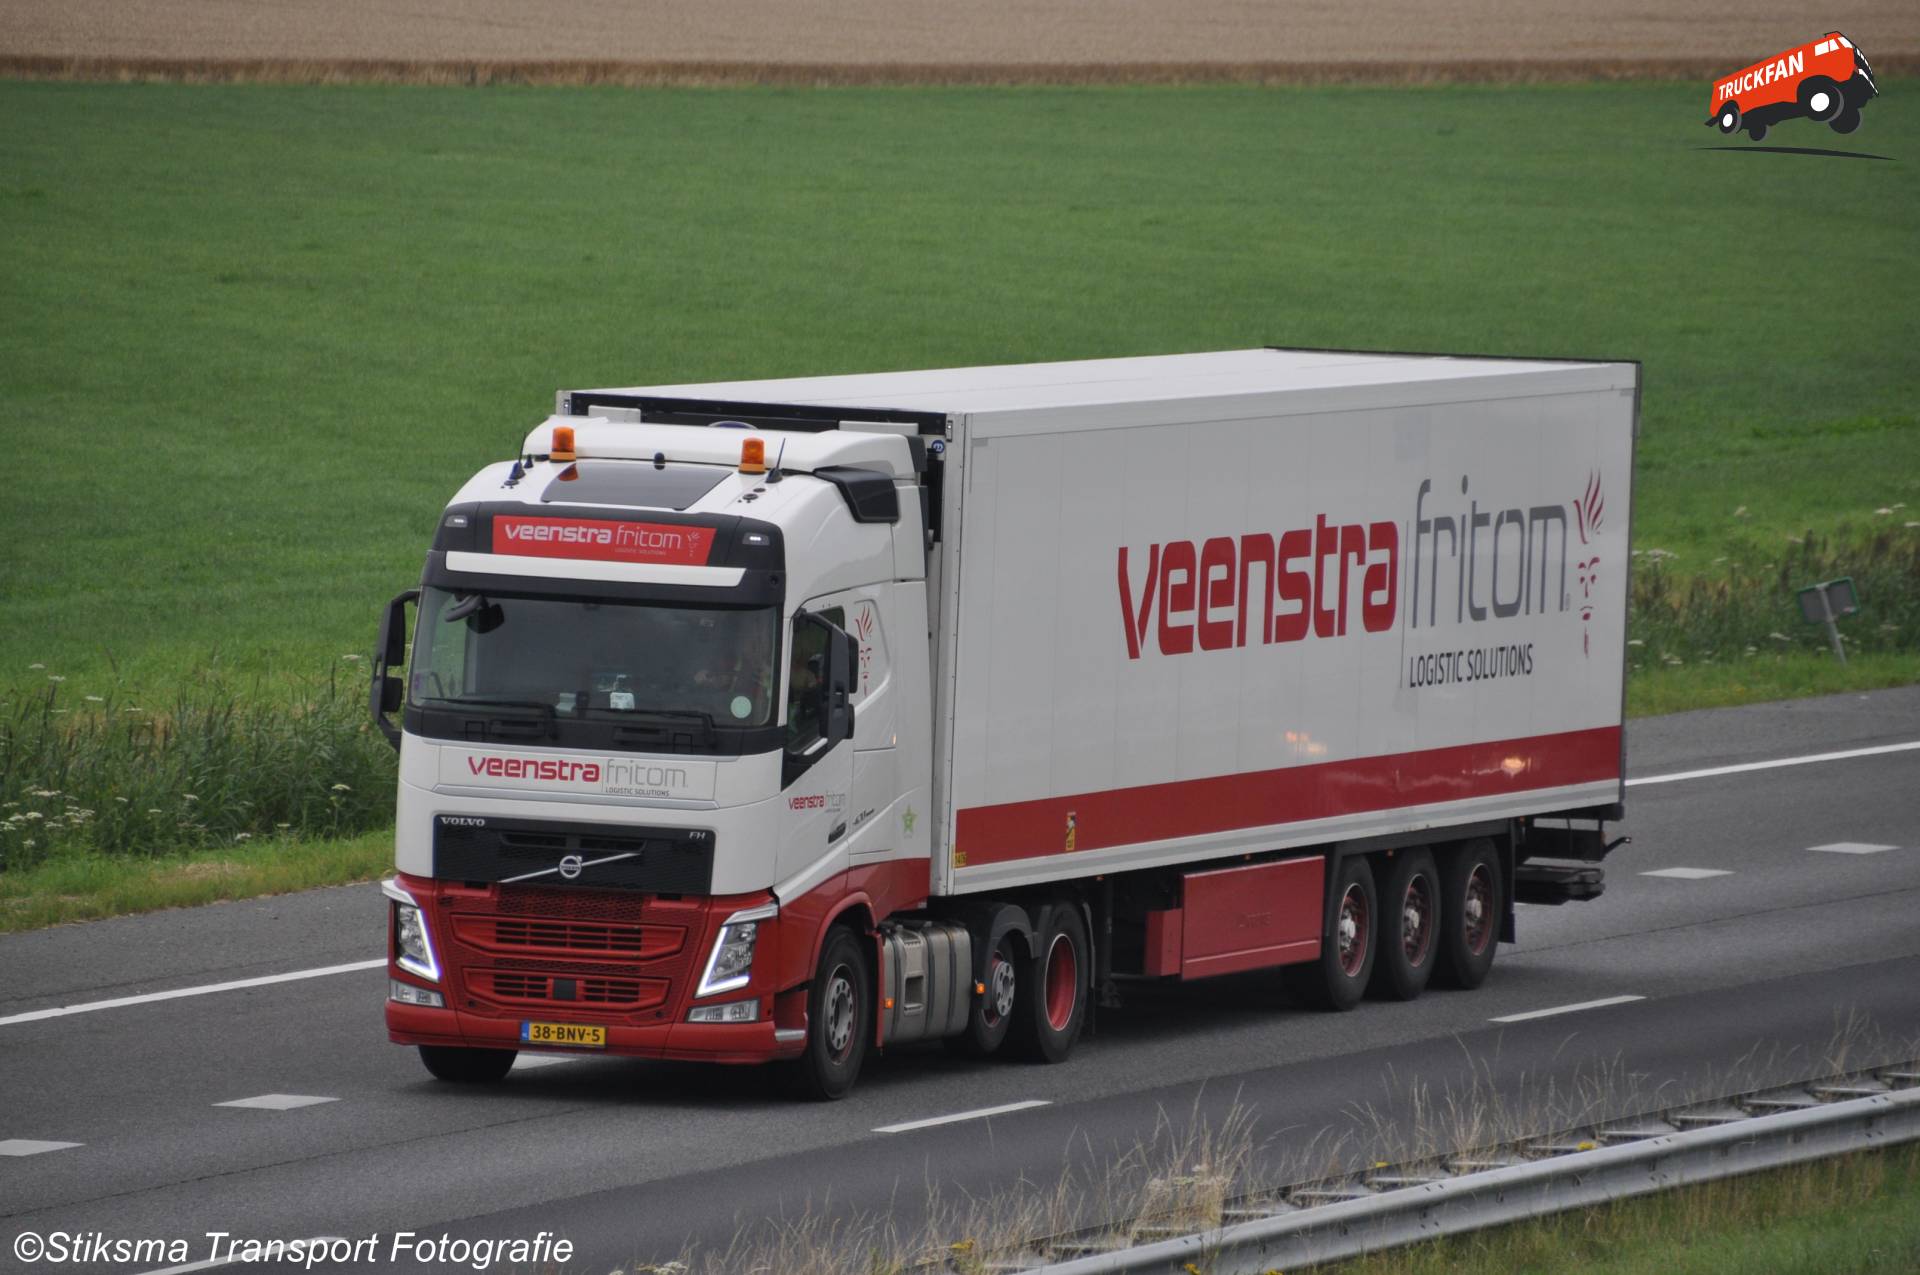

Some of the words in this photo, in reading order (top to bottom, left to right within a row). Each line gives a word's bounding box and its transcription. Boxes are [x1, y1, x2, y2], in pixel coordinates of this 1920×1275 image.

[505, 524, 611, 544] veenstra
[616, 525, 681, 549] fritom
[1117, 513, 1399, 660] veenstra
[1411, 474, 1569, 629] fritom
[1410, 650, 1464, 688] LOGISTIC
[1466, 643, 1534, 682] SOLUTIONS
[468, 756, 600, 783] veenstra
[606, 758, 687, 788] fritom
[605, 786, 633, 796] LOGISTIC
[634, 788, 670, 798] SOLUTIONS
[440, 816, 486, 827] VOLVO
[532, 1025, 601, 1042] 38-BNV-5
